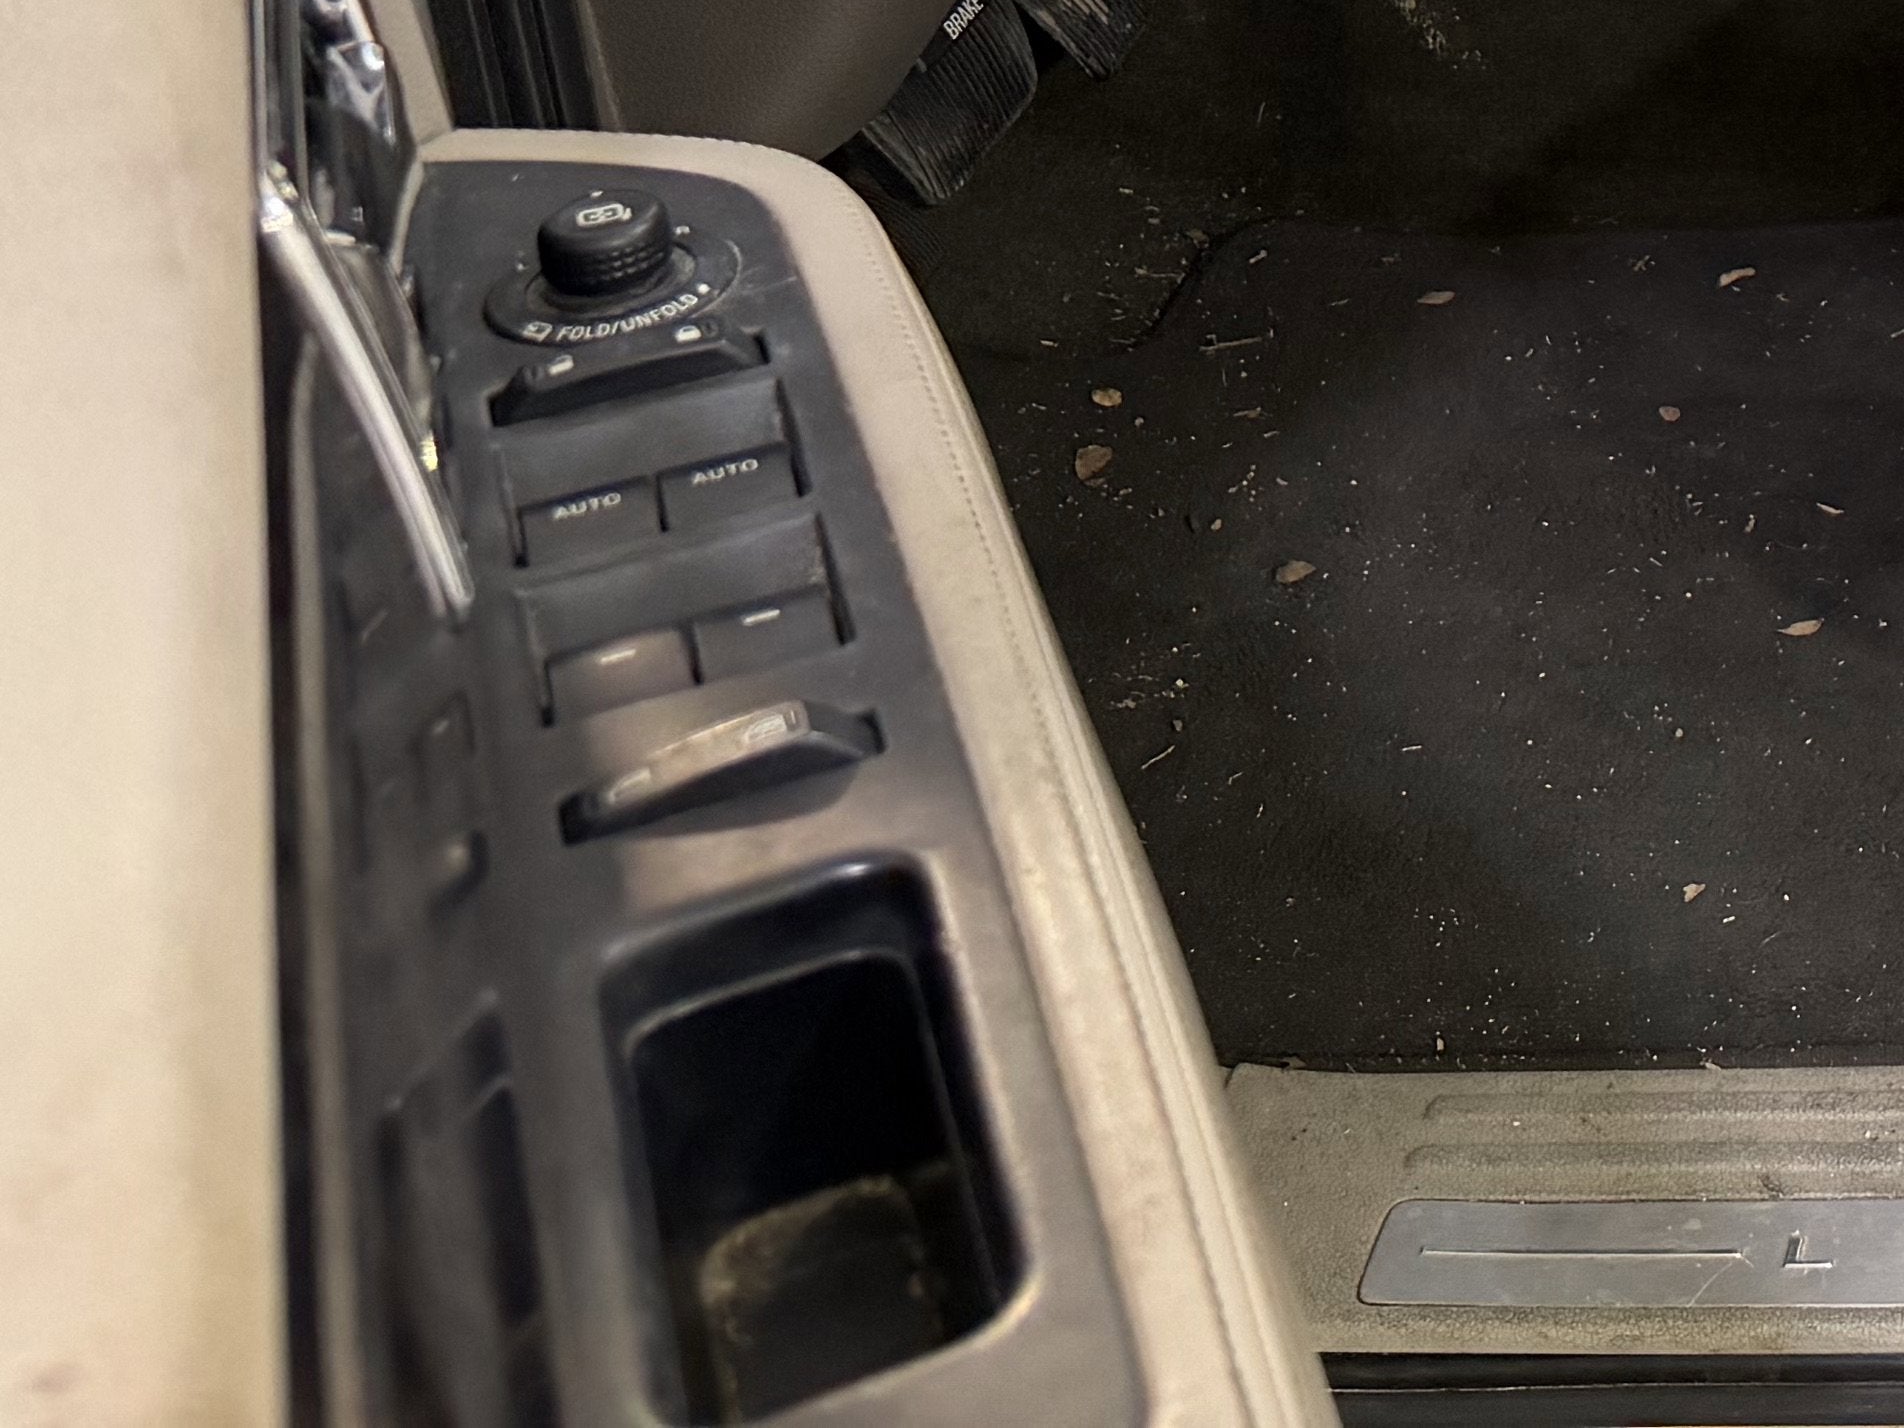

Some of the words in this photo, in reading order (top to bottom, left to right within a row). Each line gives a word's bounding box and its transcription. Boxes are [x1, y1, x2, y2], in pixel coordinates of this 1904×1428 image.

[556, 294, 699, 342] FOLD/UNFOLD
[693, 458, 758, 485] AUTO
[554, 492, 622, 519] AUTO
